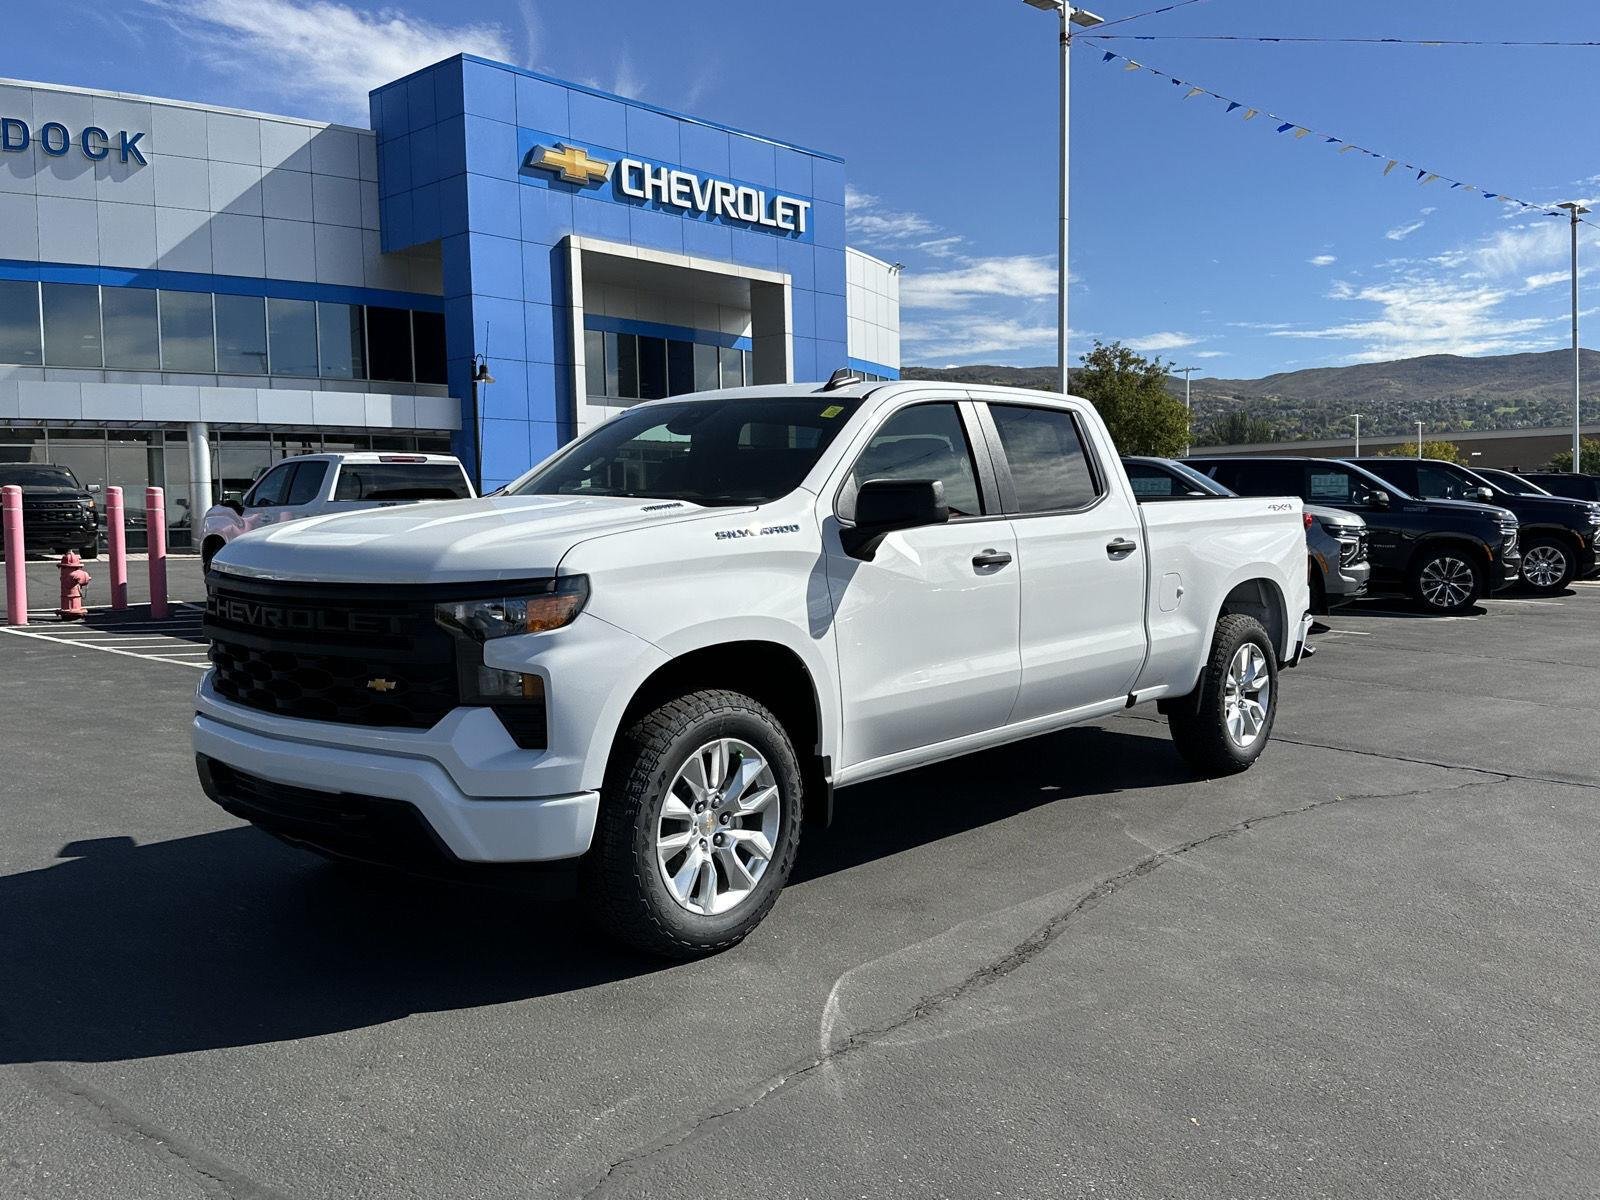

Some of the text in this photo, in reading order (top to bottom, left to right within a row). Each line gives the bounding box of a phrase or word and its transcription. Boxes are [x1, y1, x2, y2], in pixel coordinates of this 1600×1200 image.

[1, 118, 147, 166] DOCK
[621, 158, 811, 232] CHEVROLET
[206, 597, 416, 633] CHEVROLET
